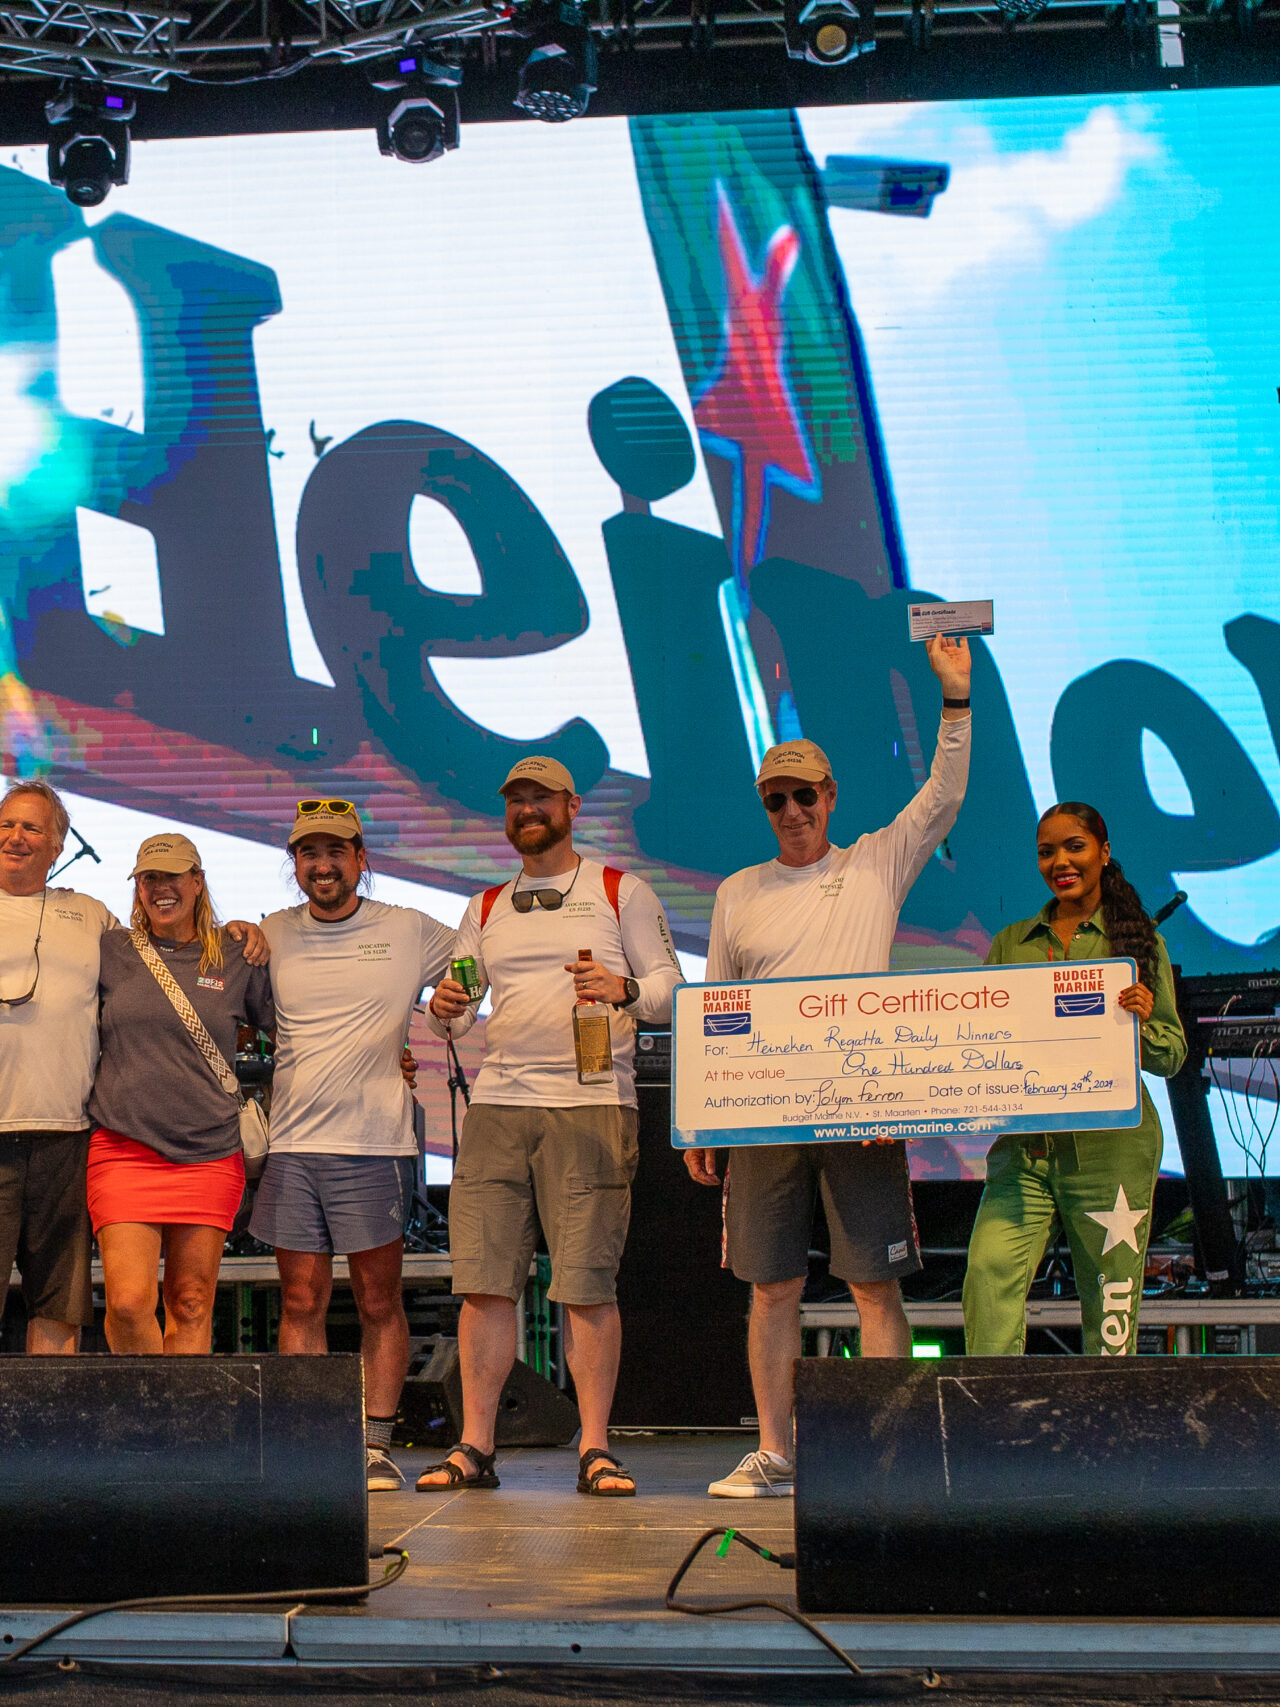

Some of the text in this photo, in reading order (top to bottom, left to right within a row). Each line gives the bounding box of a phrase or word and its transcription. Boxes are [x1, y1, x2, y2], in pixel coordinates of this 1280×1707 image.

[1054, 969, 1104, 982] BUDGET
[704, 989, 751, 1001] BUDGET
[1054, 980, 1104, 993] MARINE
[704, 1001, 751, 1013] MARINE
[799, 986, 1010, 1018] Gift Certificate
[705, 1022, 1012, 1056] For: Heineken Regatta Daily Winners
[704, 1048, 1024, 1082] At the value One Hundred Dollars
[704, 1094, 790, 1108] Authorization
[795, 1093, 816, 1106] by:
[929, 1085, 962, 1098] Date
[968, 1083, 984, 1096] of
[986, 1082, 1023, 1096] issue:
[1023, 1070, 1067, 1100] February
[783, 1113, 812, 1123] Budget
[872, 1109, 883, 1118] St.
[885, 1107, 920, 1117] Maarten
[931, 1105, 961, 1115] Phone:
[963, 1103, 1023, 1113] 721-544-3134
[814, 1120, 991, 1138] www.budgetmarine.com
